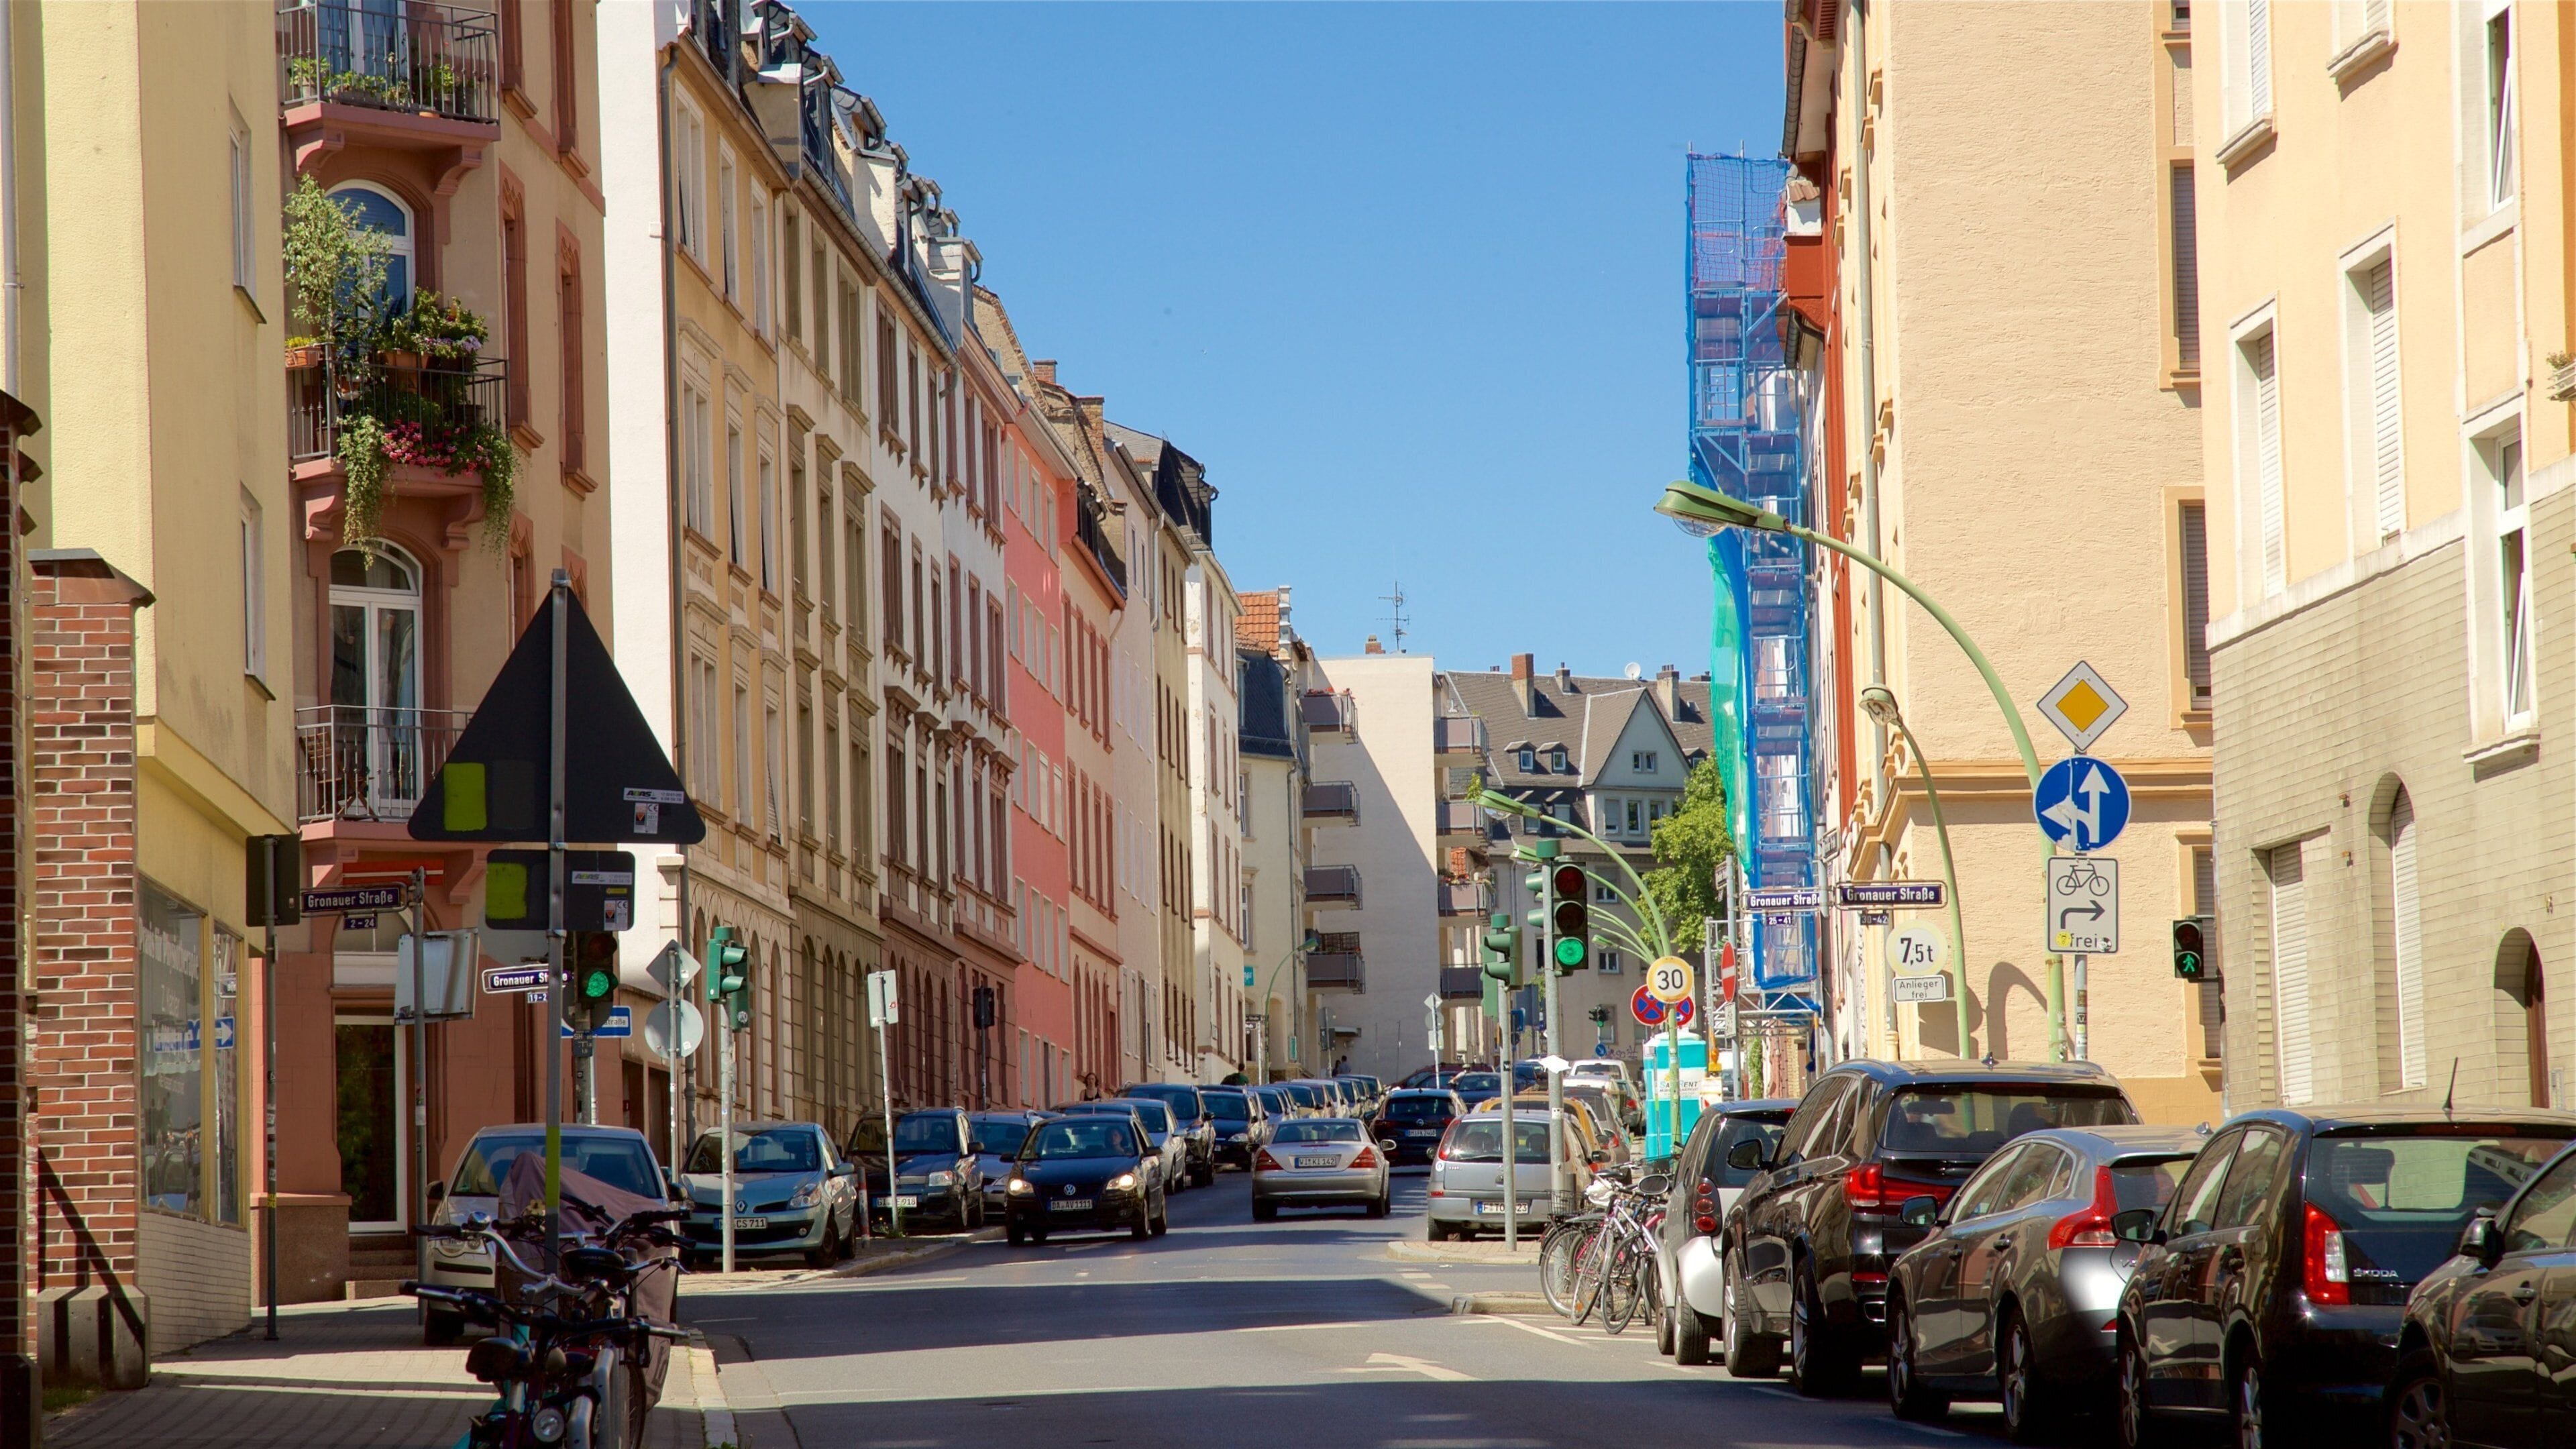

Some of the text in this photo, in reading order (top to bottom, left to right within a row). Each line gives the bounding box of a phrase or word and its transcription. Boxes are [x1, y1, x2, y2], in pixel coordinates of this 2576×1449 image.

[308, 891, 393, 908] Gronauer Straße
[1847, 887, 1935, 901] Gronauer Straße
[1750, 896, 1791, 907] Gronauer
[2070, 933, 2098, 947] frei
[493, 972, 568, 987] Gronauer Ste
[1657, 969, 1683, 990] 30
[1899, 981, 1939, 989] Anlieger
[529, 993, 547, 1002] 19-2
[1912, 990, 1927, 998] frei
